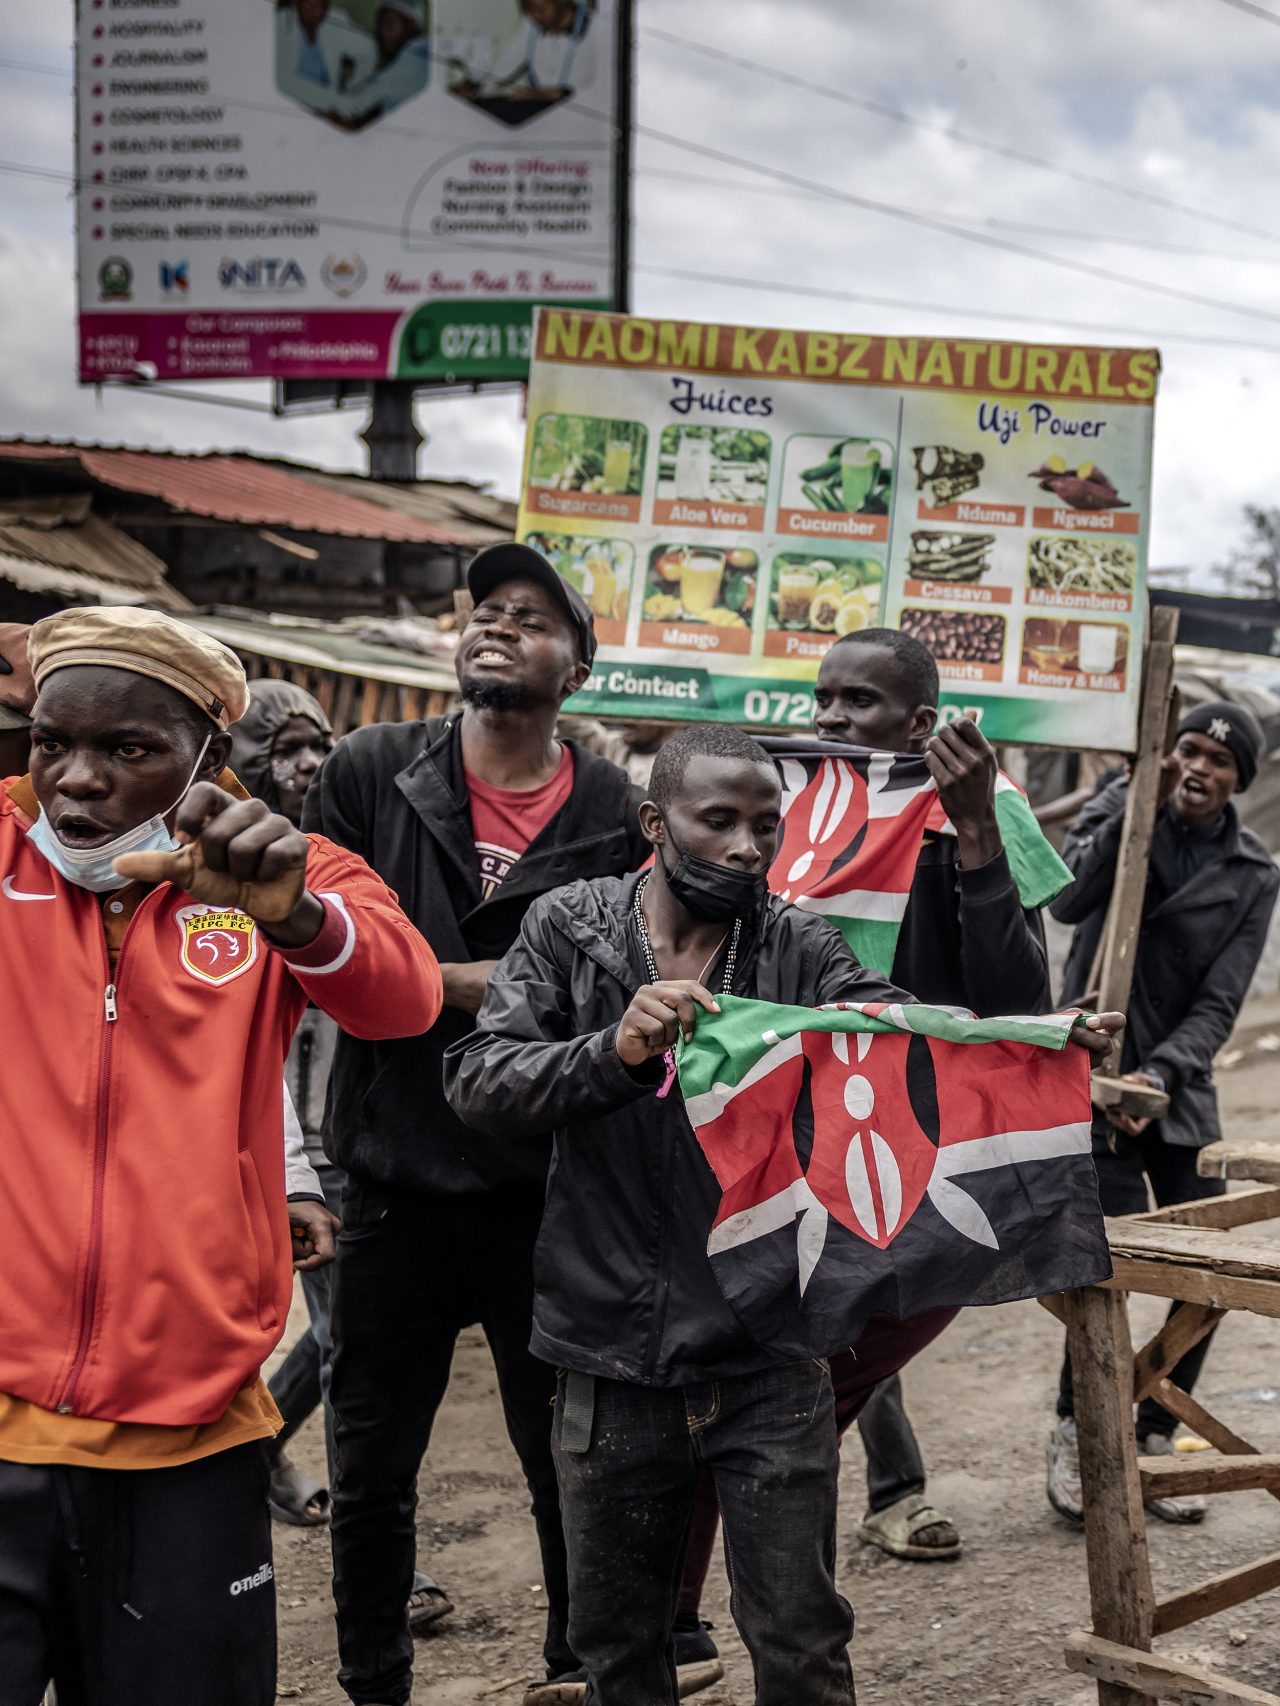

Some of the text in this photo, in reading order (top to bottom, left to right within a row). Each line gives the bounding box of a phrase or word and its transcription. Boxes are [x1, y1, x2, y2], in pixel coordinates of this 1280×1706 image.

[440, 323, 501, 359] 0721
[544, 312, 1158, 399] NAOMI KABZ NATURALS
[669, 376, 774, 417] Juices
[978, 401, 1107, 444] Uji Power
[538, 492, 630, 516] Sugarcane
[957, 505, 1017, 525] Nduma
[669, 506, 748, 527] Aloe Vera
[788, 514, 876, 538] Cucumber
[1053, 509, 1115, 531] Ngwaci
[920, 581, 993, 602] Cassava
[1029, 588, 1129, 611] Mukombero
[662, 627, 720, 650] Mango
[1027, 669, 1121, 691] Honey & Milk
[608, 670, 699, 699] Contact
[744, 689, 817, 726] 072
[192, 920, 246, 931] SIPG FC
